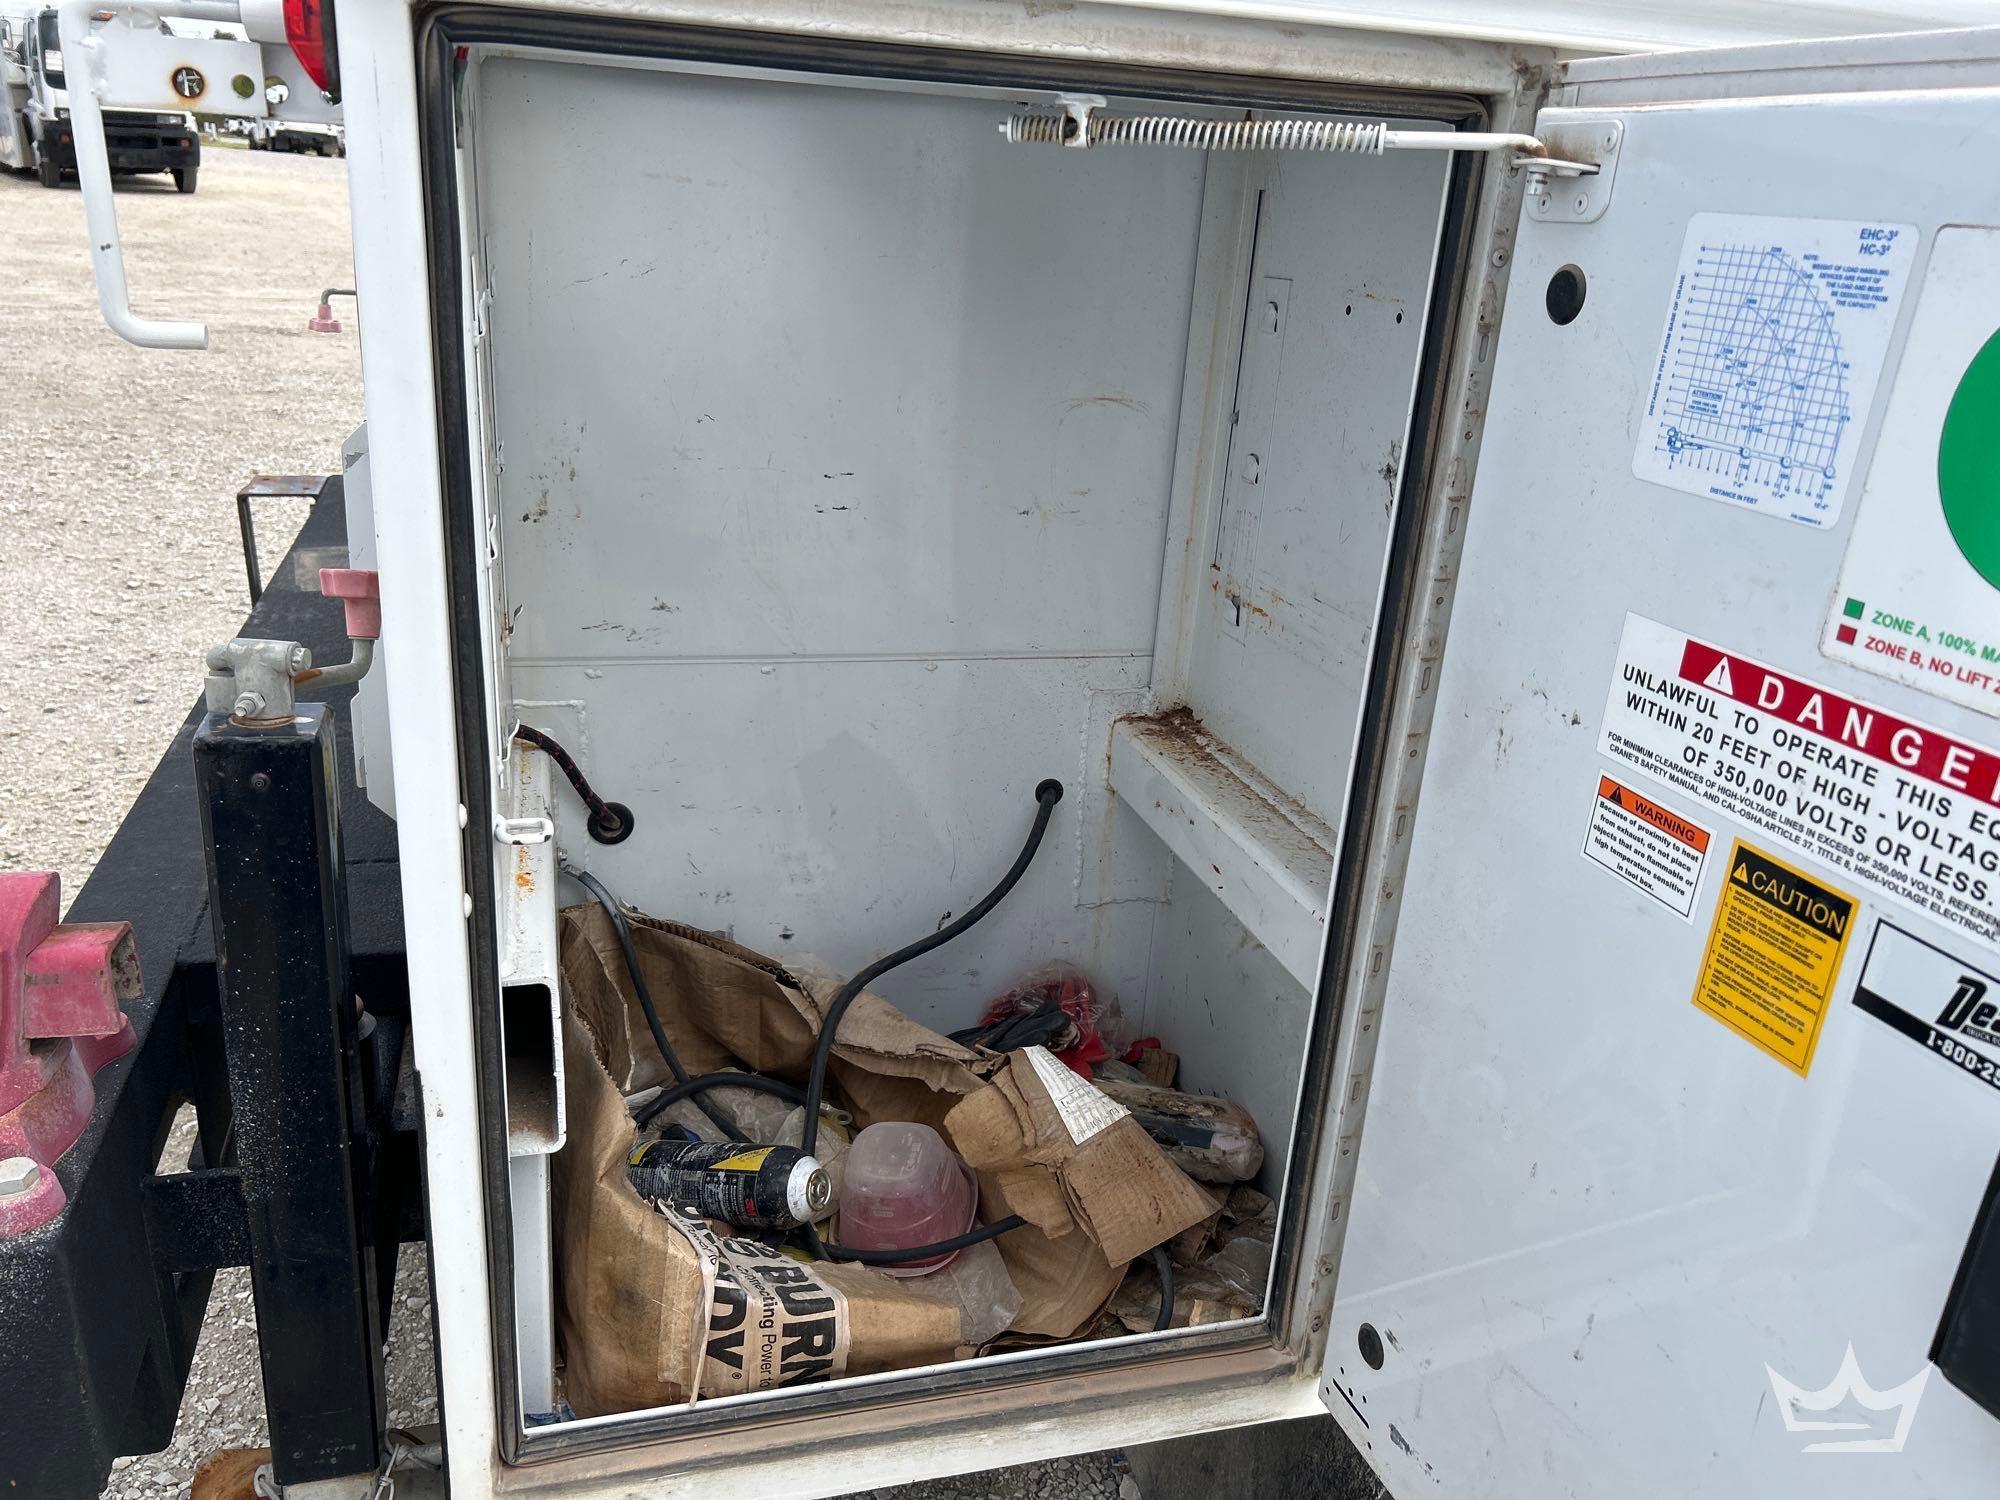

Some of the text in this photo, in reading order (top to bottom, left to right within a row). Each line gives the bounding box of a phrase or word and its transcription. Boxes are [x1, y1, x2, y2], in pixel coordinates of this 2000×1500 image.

[1864, 636, 1907, 661] ZONE
[1910, 649, 1924, 670] B,
[1928, 657, 1953, 676] NO
[1956, 667, 1993, 690] LIFT
[1872, 610, 1916, 636] ZONE
[1916, 625, 1931, 642] A,
[1938, 631, 1976, 656] 100%
[1623, 663, 1718, 720] UNLAWFUL
[1734, 710, 1759, 735] TO
[1773, 728, 1879, 787] OPERATE
[1896, 778, 1952, 818] THIS
[1607, 729, 1622, 744] FOR
[1622, 737, 1653, 759] MINIMUM
[1654, 752, 1704, 784] CLEARANCES
[1705, 777, 1716, 790] OF
[1716, 782, 1777, 820] HIGH-VOLTAGE
[1778, 812, 1804, 834] LINES
[1805, 825, 1814, 839] IN
[1816, 830, 1854, 858] EXCESS
[1855, 849, 1870, 866] OF
[1871, 857, 1907, 884] 350,000
[1627, 691, 1687, 732] WITHIN
[1692, 722, 1713, 744] 20
[1719, 733, 1772, 769] FEET
[1777, 760, 1807, 783] OF
[1812, 775, 1871, 815] HIGH
[1897, 811, 1999, 872] VOLTAG
[1599, 800, 1699, 863] Because of proximity to heat
[1600, 814, 1691, 872] from exhaust, do not place
[1609, 742, 1639, 764] CRANE'S
[1639, 757, 1667, 778] SAFETY
[1668, 771, 1701, 795] MANUAL,
[1702, 788, 1719, 804] AND
[1720, 797, 1762, 826] CAL-OSHA
[1763, 818, 1800, 844] ARTICLE
[1816, 844, 1841, 865] TITLE
[1853, 862, 1926, 908] HIGH-VOLTAGE
[1929, 899, 1997, 943] ELECTRICAL
[1635, 799, 1695, 842] WARNING
[1683, 746, 1992, 906] OF 350,000 VOLTS OR LESS.
[1593, 824, 1694, 887] objects that are flammable or
[1594, 836, 1685, 896] high temperature sensitive
[1616, 862, 1654, 891] in tool box.
[1752, 871, 1846, 934] CAUTION
[759, 1333, 777, 1374] Power
